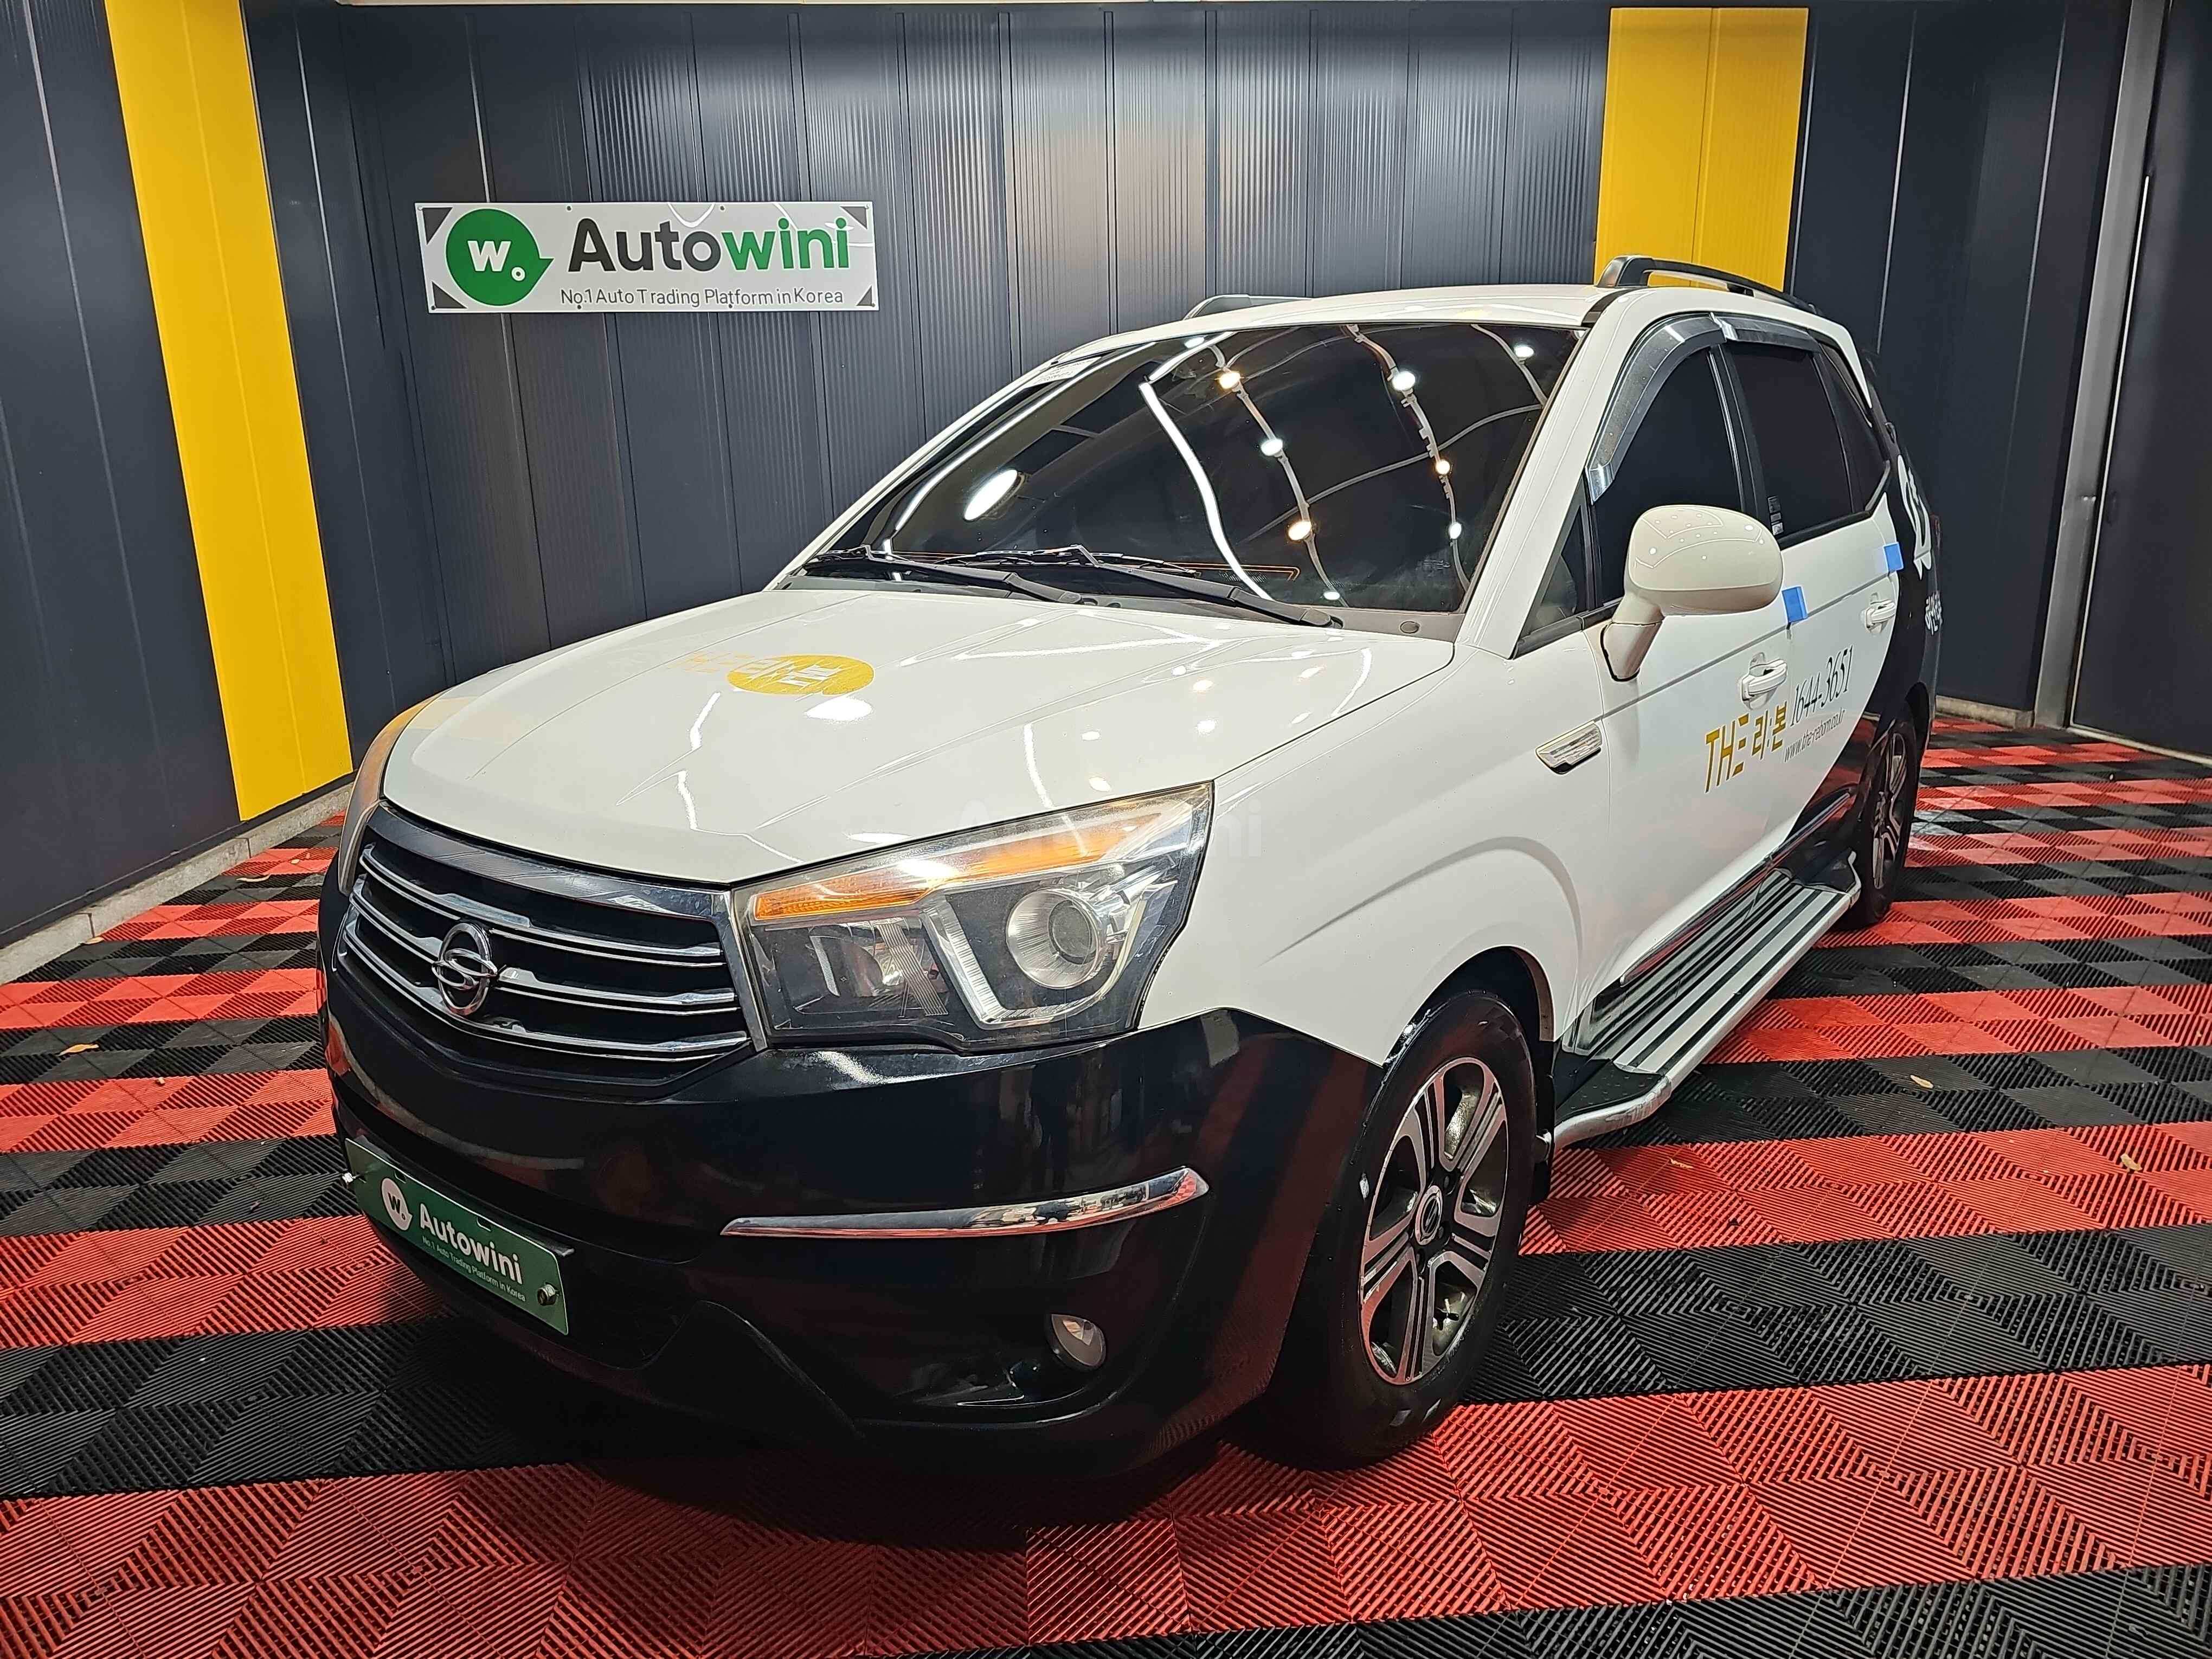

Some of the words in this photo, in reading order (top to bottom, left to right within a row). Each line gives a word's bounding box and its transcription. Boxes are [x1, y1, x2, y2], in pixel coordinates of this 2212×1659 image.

[568, 217, 850, 272] Autowini
[561, 288, 593, 304] No.1
[596, 288, 634, 304] Auto
[636, 288, 700, 308] Trading
[704, 288, 773, 305] Platform
[776, 288, 792, 304] in
[793, 287, 844, 304] Korea
[1790, 645, 1853, 728] 1644-3651
[420, 1203, 523, 1284] Autowini
[449, 1251, 472, 1274] Trading
[471, 1264, 499, 1288] Platform
[506, 1284, 526, 1302] Korea
